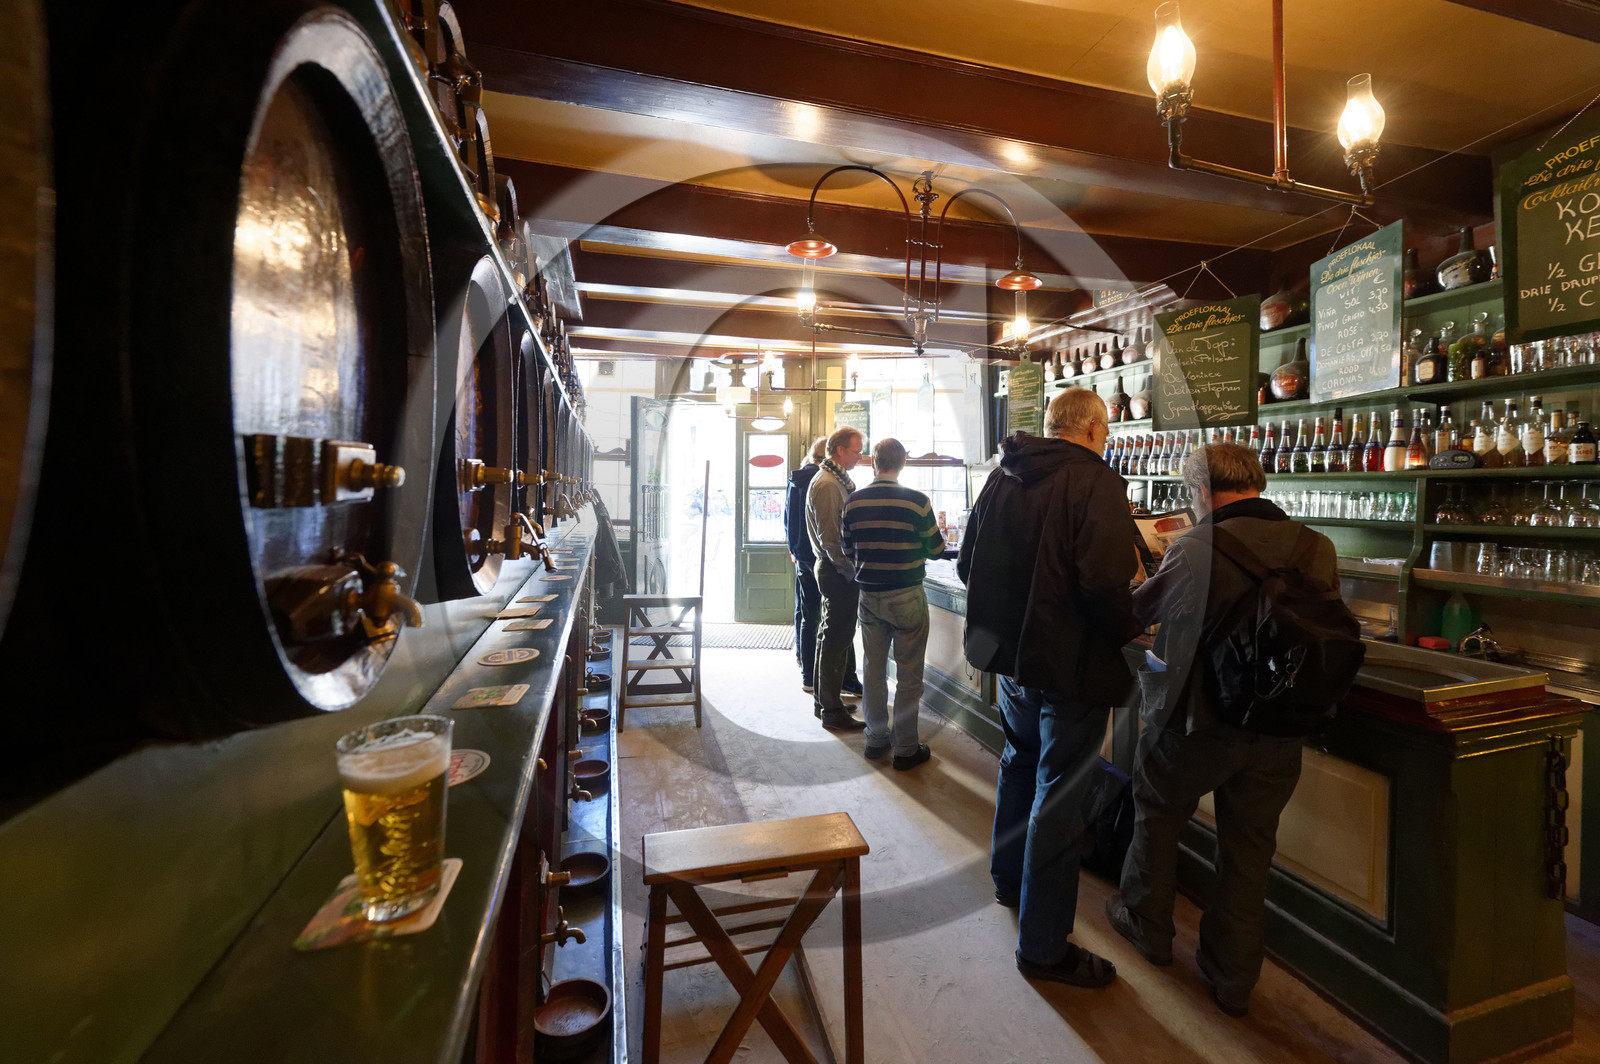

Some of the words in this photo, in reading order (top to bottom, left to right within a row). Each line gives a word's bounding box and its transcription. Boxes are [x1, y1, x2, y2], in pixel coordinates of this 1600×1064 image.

[1524, 170, 1552, 186] De
[1556, 159, 1593, 177] drie
[1328, 241, 1376, 270] PROEFLOKAAL
[1320, 271, 1334, 284] De
[1335, 266, 1349, 277] drie
[1327, 281, 1347, 295] Open
[1520, 285, 1551, 299] DRIE
[1561, 275, 1600, 291] DRUP
[1344, 296, 1360, 309] SOL
[1174, 305, 1231, 328] PROEFLOKAAL
[1166, 324, 1183, 335] De
[1184, 321, 1202, 331] drie
[1317, 318, 1338, 332] PINOT
[1165, 341, 1184, 354] Van
[1186, 341, 1200, 353] de
[1320, 346, 1332, 357] DE
[1336, 338, 1364, 354] CASTA
[1163, 373, 1182, 383] De
[1321, 374, 1364, 390] CORONAS
